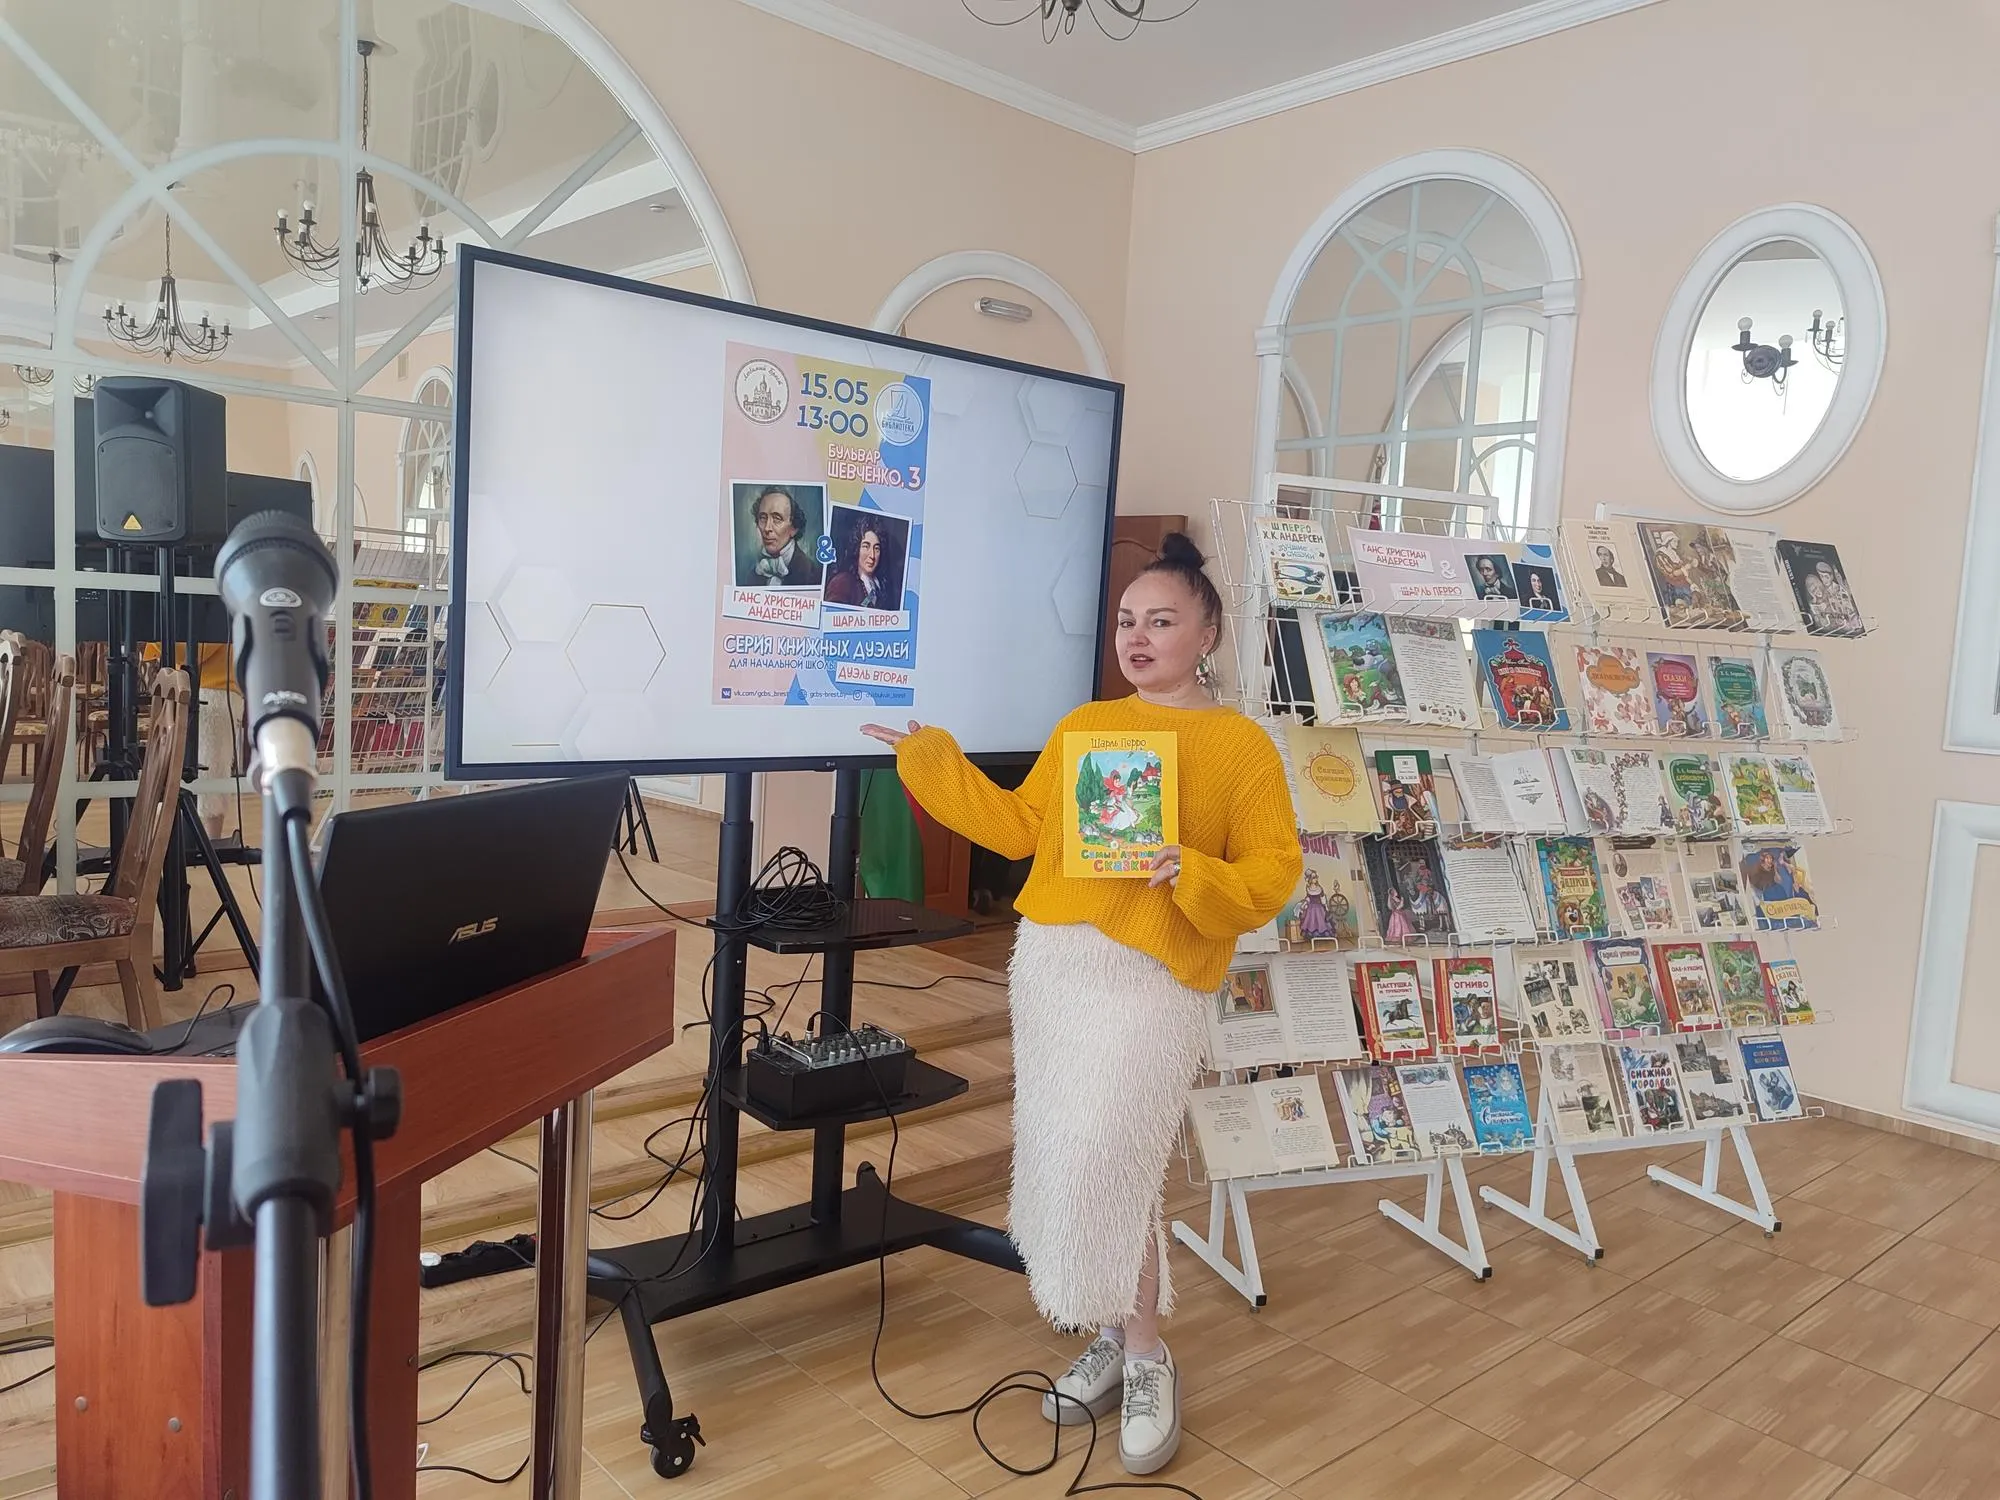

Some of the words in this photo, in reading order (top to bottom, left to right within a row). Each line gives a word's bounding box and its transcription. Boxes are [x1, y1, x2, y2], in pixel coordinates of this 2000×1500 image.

[801, 372, 869, 406] 15.05
[796, 405, 869, 438] 13:00
[828, 443, 881, 465] БУЛЬВАР
[827, 460, 905, 489] ШЕВЧЕНКО,
[908, 466, 922, 489] 3
[1280, 532, 1324, 543] АНДЕРСЕН
[816, 535, 837, 564] &
[1362, 544, 1383, 555] ГАНС
[1386, 547, 1427, 560] ХРИСТИАН
[1376, 555, 1419, 568] АНДЕРСЕН
[1433, 586, 1463, 597] ПЕРРО
[733, 590, 760, 604] ГАНС
[764, 593, 815, 611] ХРИСТИАН
[748, 607, 803, 622] АНДЕРСЕН
[832, 615, 866, 627] ШАРЛЬ
[868, 614, 900, 626] ПЕРРО
[723, 634, 773, 656] СЕРИЯ
[777, 636, 851, 659] КНИЖНЫХ
[853, 637, 910, 661] ДУЭЛЕЙ
[729, 659, 748, 669] ДЛЯ
[750, 658, 803, 671] НАЧАЛЬНОЙ
[838, 666, 871, 681] ДУЭЛЬ
[872, 670, 908, 685] ВТОРАЯ
[1090, 737, 1119, 750] Шарль
[1120, 737, 1147, 751] Перро
[1299, 833, 1341, 860] УШКА
[1120, 850, 1156, 860] лучши
[447, 916, 499, 946] ASUS
[1453, 980, 1489, 989] ОГНИВО
[1630, 1067, 1673, 1080] СНЕЖНАЯ
[1631, 1077, 1677, 1089] КОРОЛЕВА
